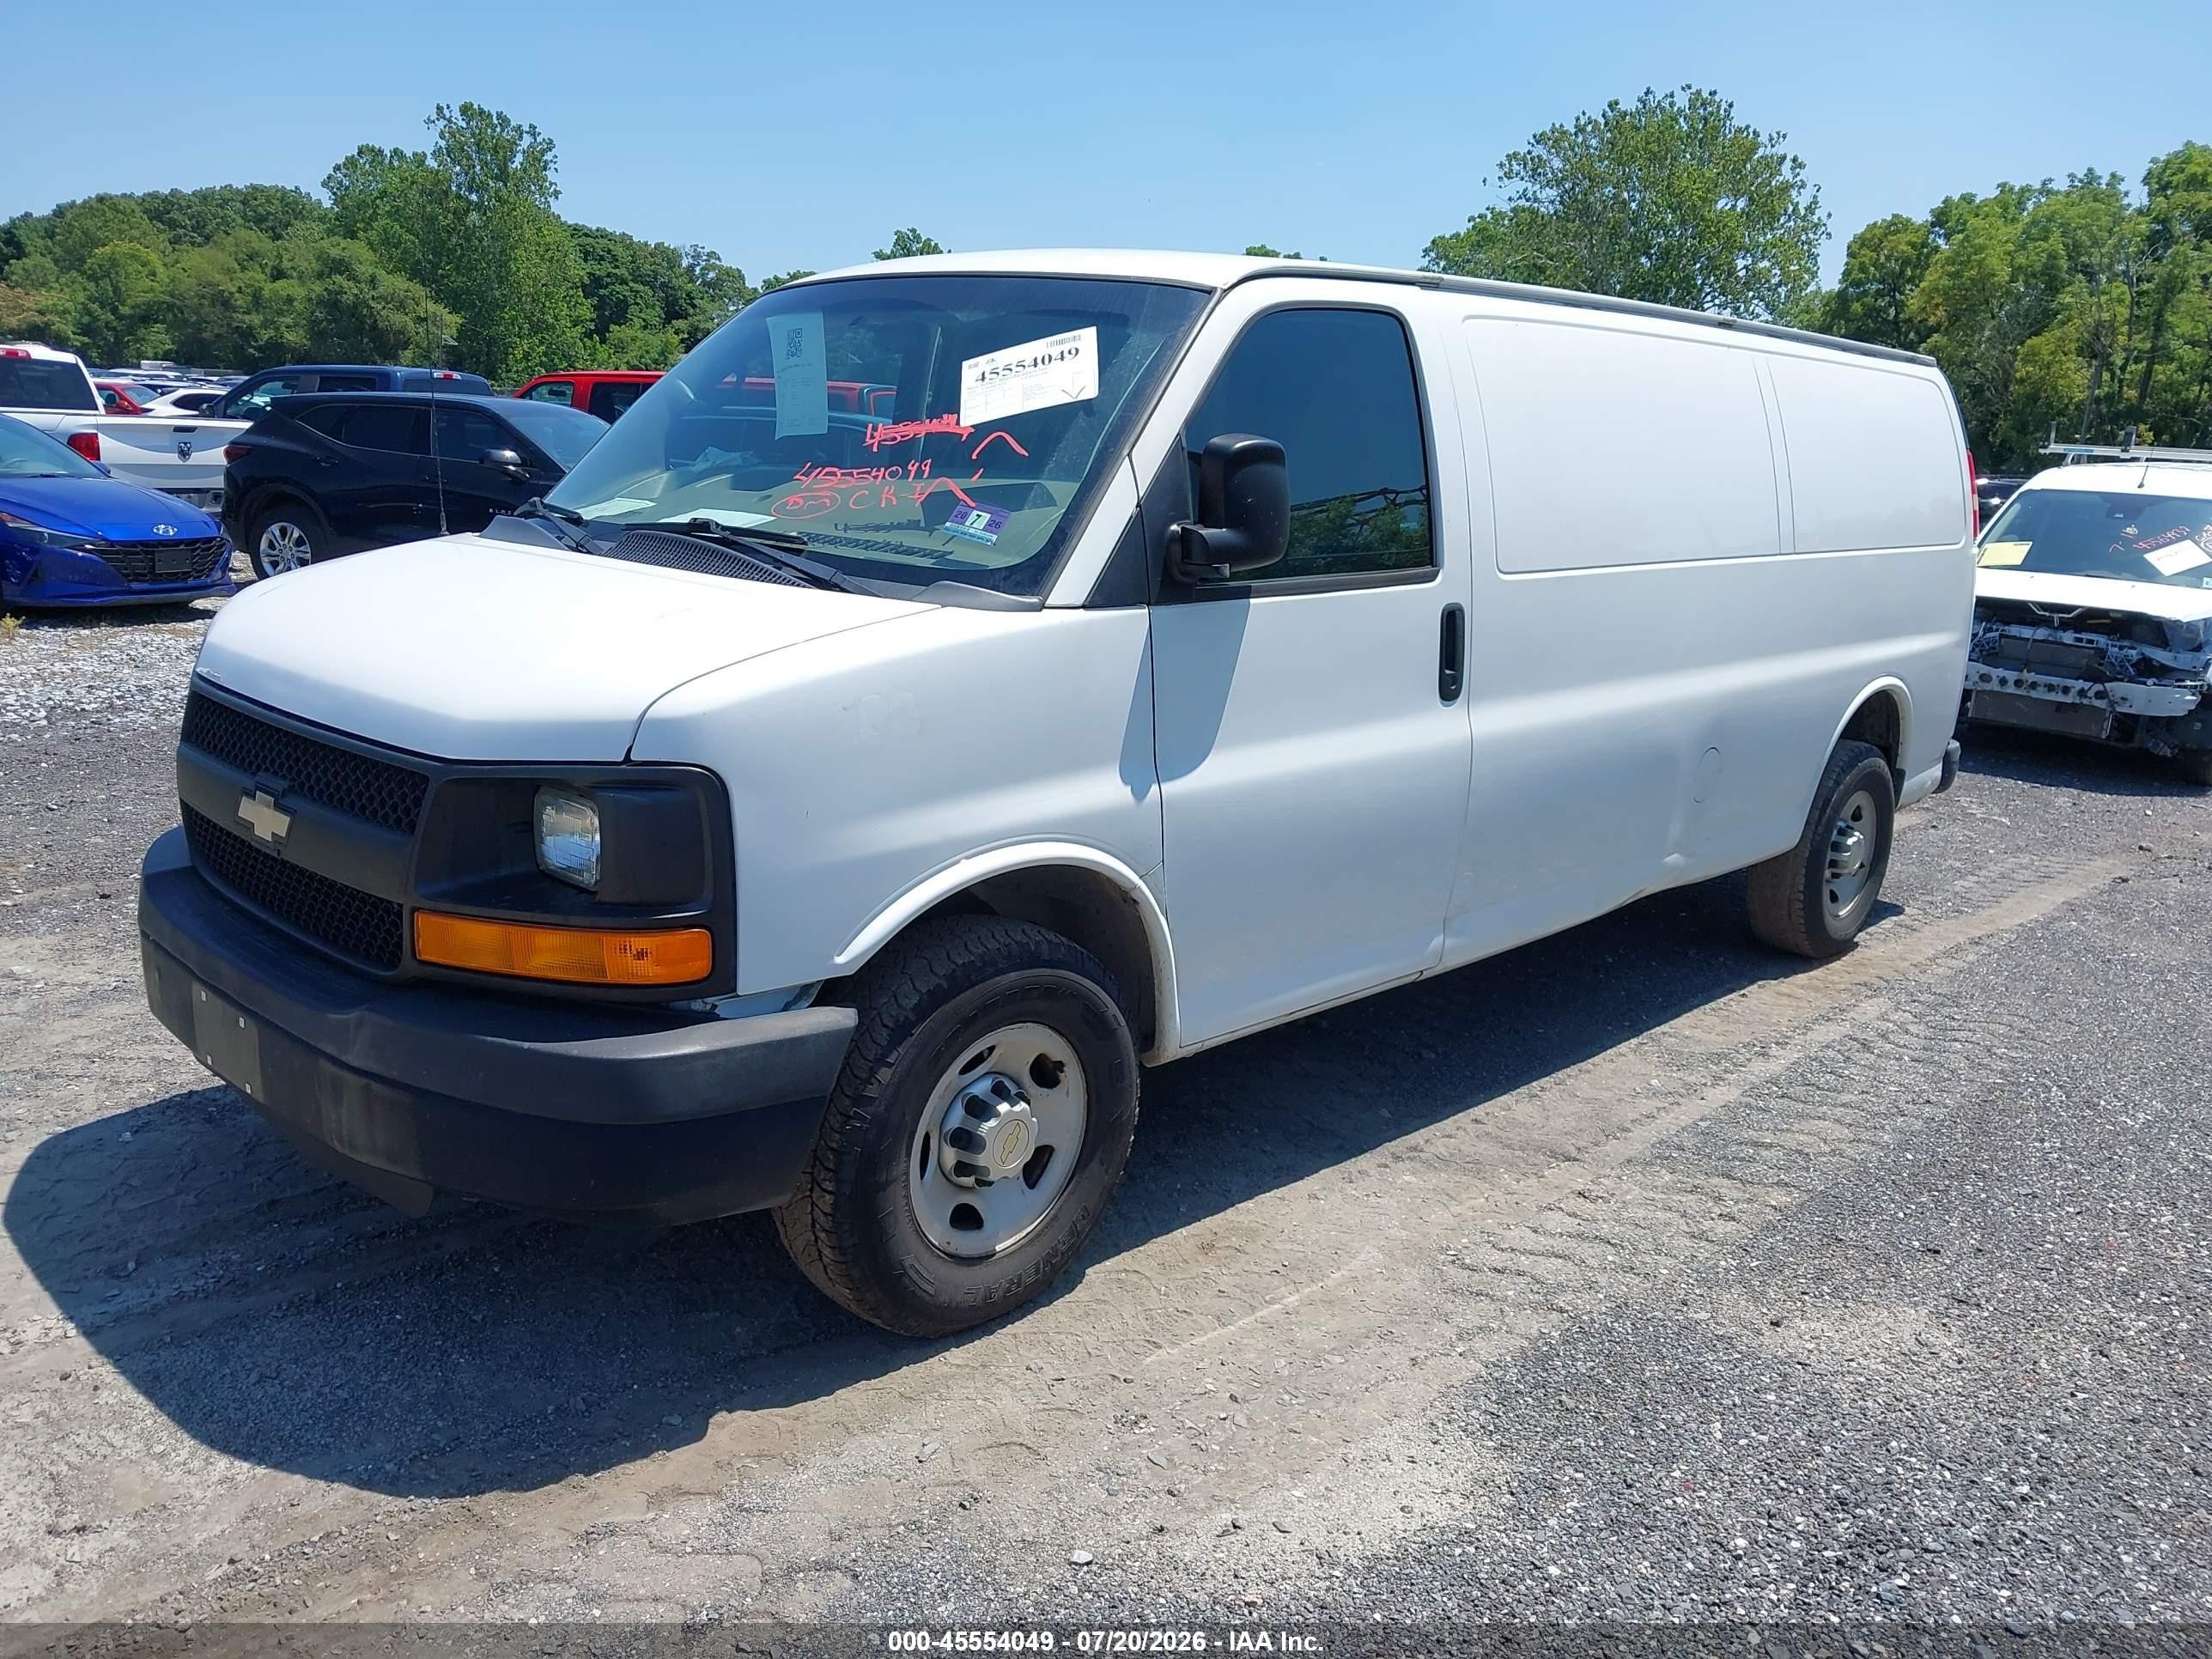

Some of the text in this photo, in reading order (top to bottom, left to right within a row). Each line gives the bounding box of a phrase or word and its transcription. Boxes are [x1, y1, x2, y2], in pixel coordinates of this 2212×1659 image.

[975, 346, 1080, 383] 45554049
[954, 510, 969, 520] 20
[969, 514, 983, 526] 7
[988, 519, 1004, 529] 26
